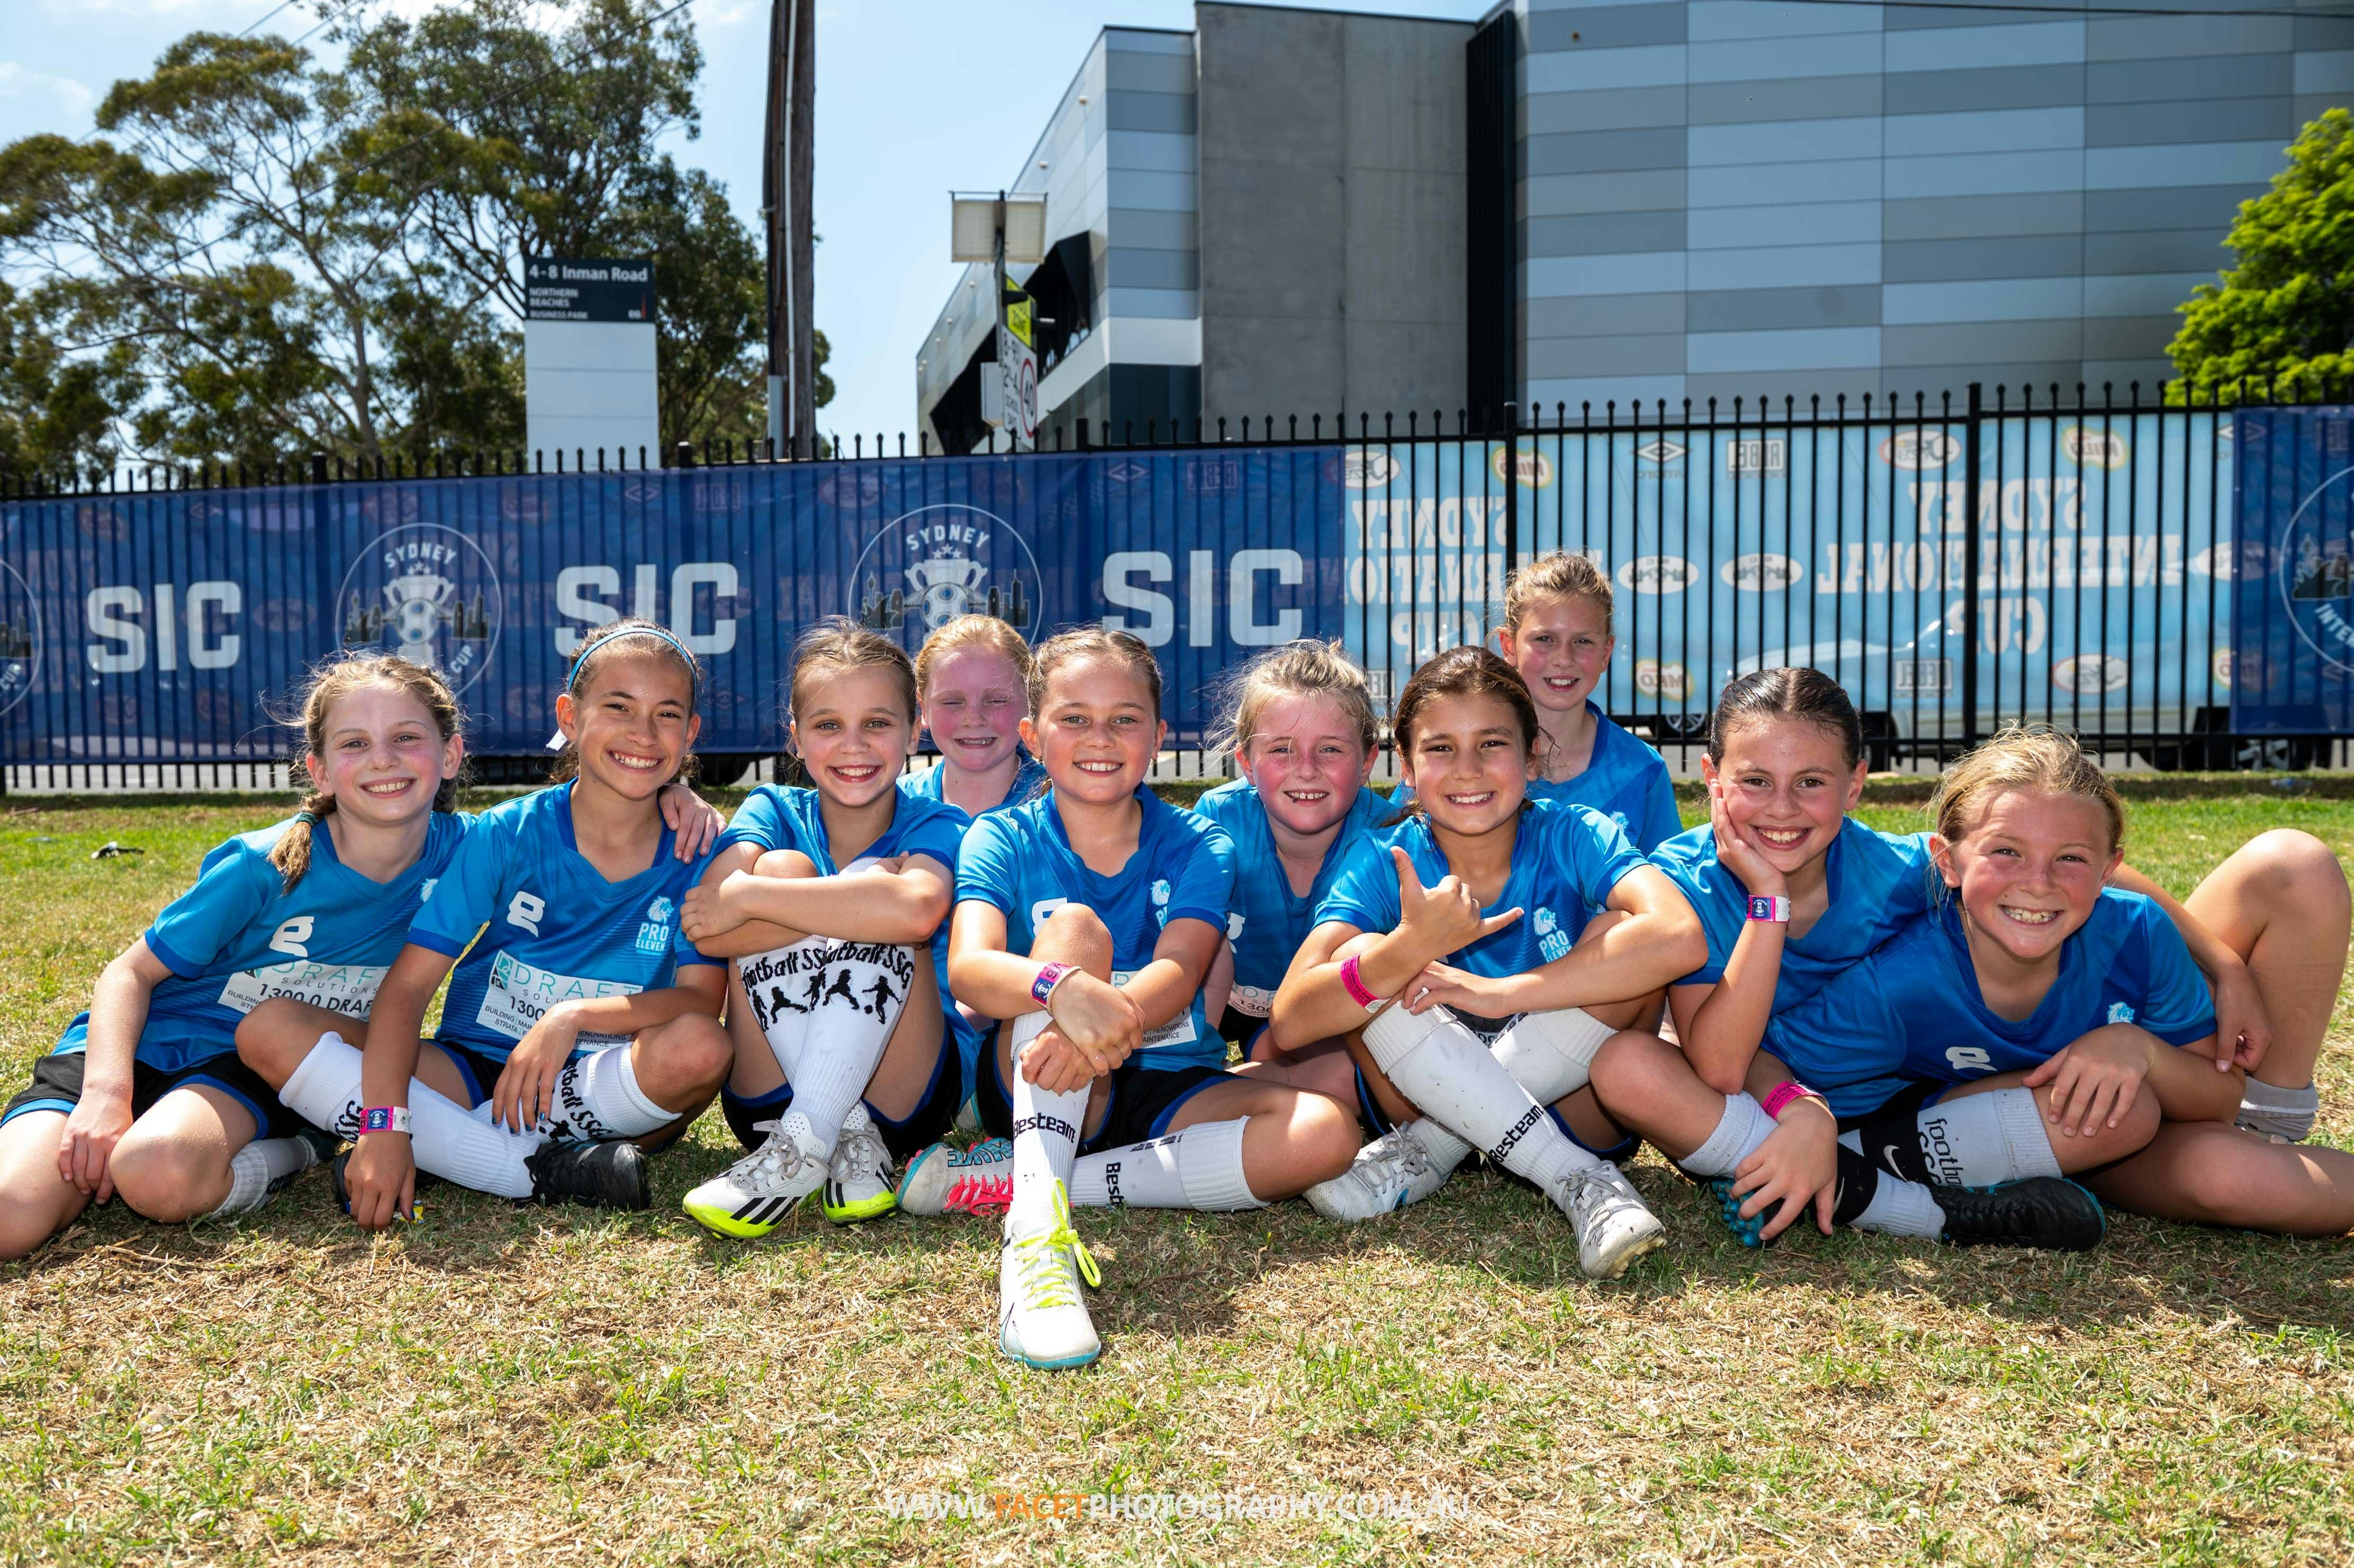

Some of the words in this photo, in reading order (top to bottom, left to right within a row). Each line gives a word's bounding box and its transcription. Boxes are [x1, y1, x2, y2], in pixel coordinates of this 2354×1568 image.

[563, 265, 608, 281] Inman
[611, 266, 648, 283] Road
[529, 287, 579, 298] NORTHERN
[529, 298, 570, 308] BEACHES
[906, 524, 990, 551] SYDNEY
[384, 542, 457, 569] SYDNEY
[555, 562, 738, 655] SIC
[1102, 548, 1303, 647] SIC
[87, 581, 241, 673] SIC
[450, 644, 474, 674] CUP
[638, 922, 669, 941] PRO
[636, 938, 666, 952] ELEVEN
[1539, 930, 1570, 958] PRO
[228, 989, 259, 1005] BUILDIN
[484, 1005, 515, 1023] BUILDING
[510, 996, 546, 1021] 1300
[494, 1018, 518, 1034] STRATA
[1142, 1031, 1180, 1043] AINTENANCE
[1489, 1104, 1545, 1163] Besteam
